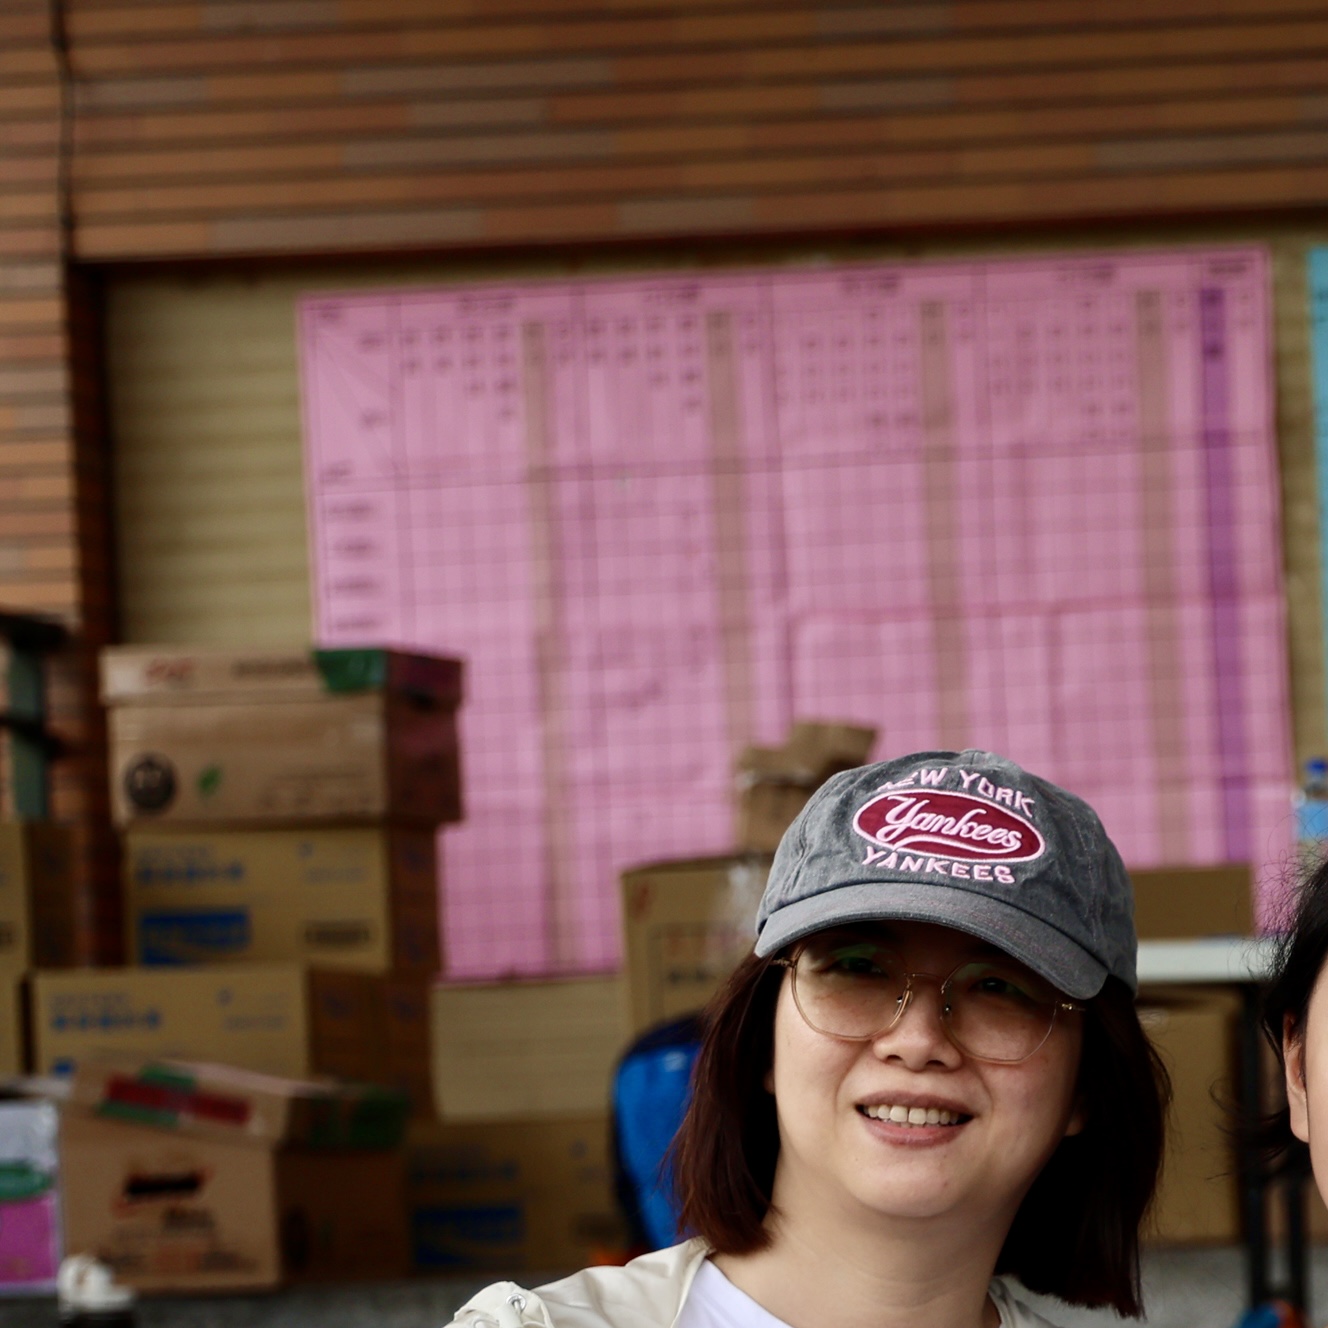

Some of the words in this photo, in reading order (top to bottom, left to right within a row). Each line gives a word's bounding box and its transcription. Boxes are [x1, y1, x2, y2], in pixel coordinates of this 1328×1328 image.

[959, 769, 1035, 818] YORK
[875, 795, 1023, 848] Yankees
[862, 845, 1016, 884] YANKEES
